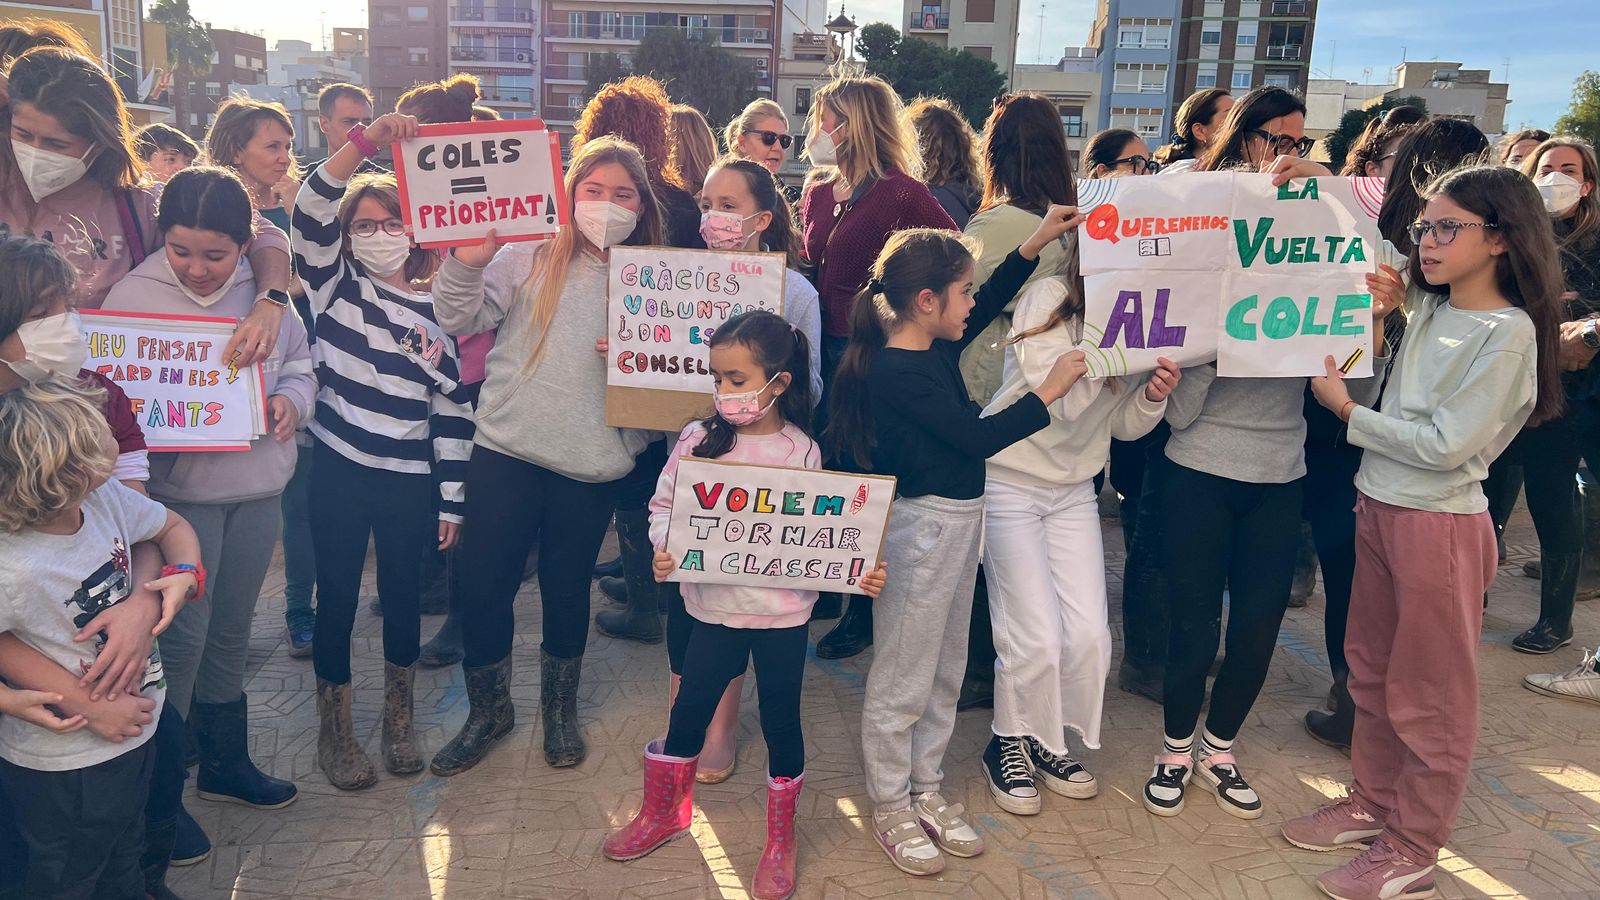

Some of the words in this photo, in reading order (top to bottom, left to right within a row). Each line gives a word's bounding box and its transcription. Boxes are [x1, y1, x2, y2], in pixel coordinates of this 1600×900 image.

[417, 138, 522, 171] COLES
[1276, 177, 1320, 201] LA
[1233, 217, 1367, 268] VUELTA
[621, 261, 740, 295] GRÀCIES
[623, 294, 775, 319] VOLUNTA
[1098, 288, 1187, 349] AL
[1225, 294, 1371, 341] COLE
[137, 336, 212, 362] PENSAT
[617, 351, 713, 375] CONSEL
[159, 367, 183, 384] EN
[189, 370, 220, 386] ELS
[692, 482, 845, 516] VOLEM
[690, 515, 861, 551] TORNAR
[679, 549, 705, 571] A
[720, 552, 865, 585] CLASSE!
